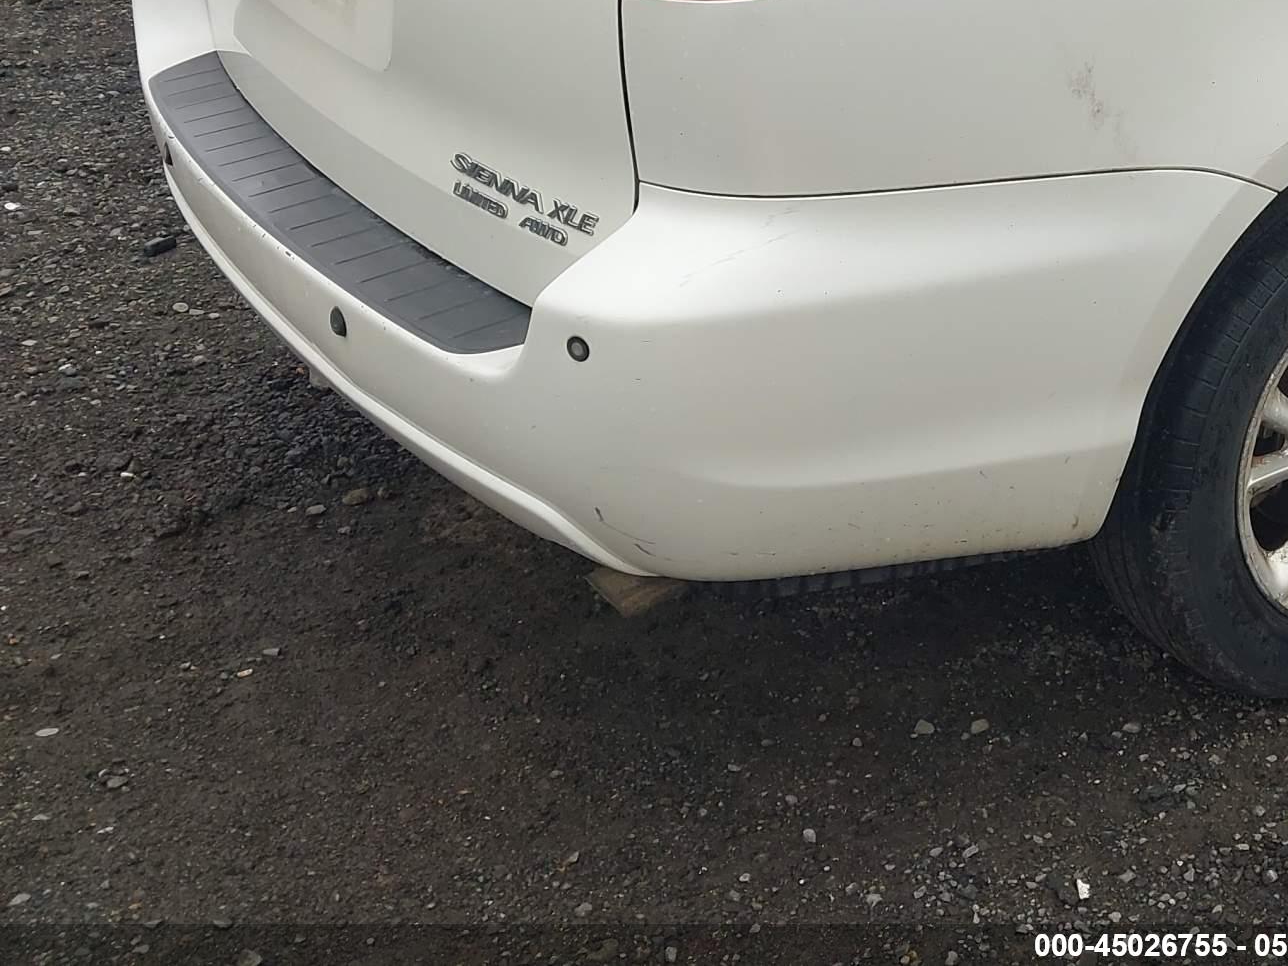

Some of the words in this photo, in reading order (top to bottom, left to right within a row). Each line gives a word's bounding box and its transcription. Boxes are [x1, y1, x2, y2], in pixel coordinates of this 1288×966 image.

[450, 152, 545, 215] SIENNA
[547, 197, 600, 237] XLE
[518, 215, 569, 247] AWD
